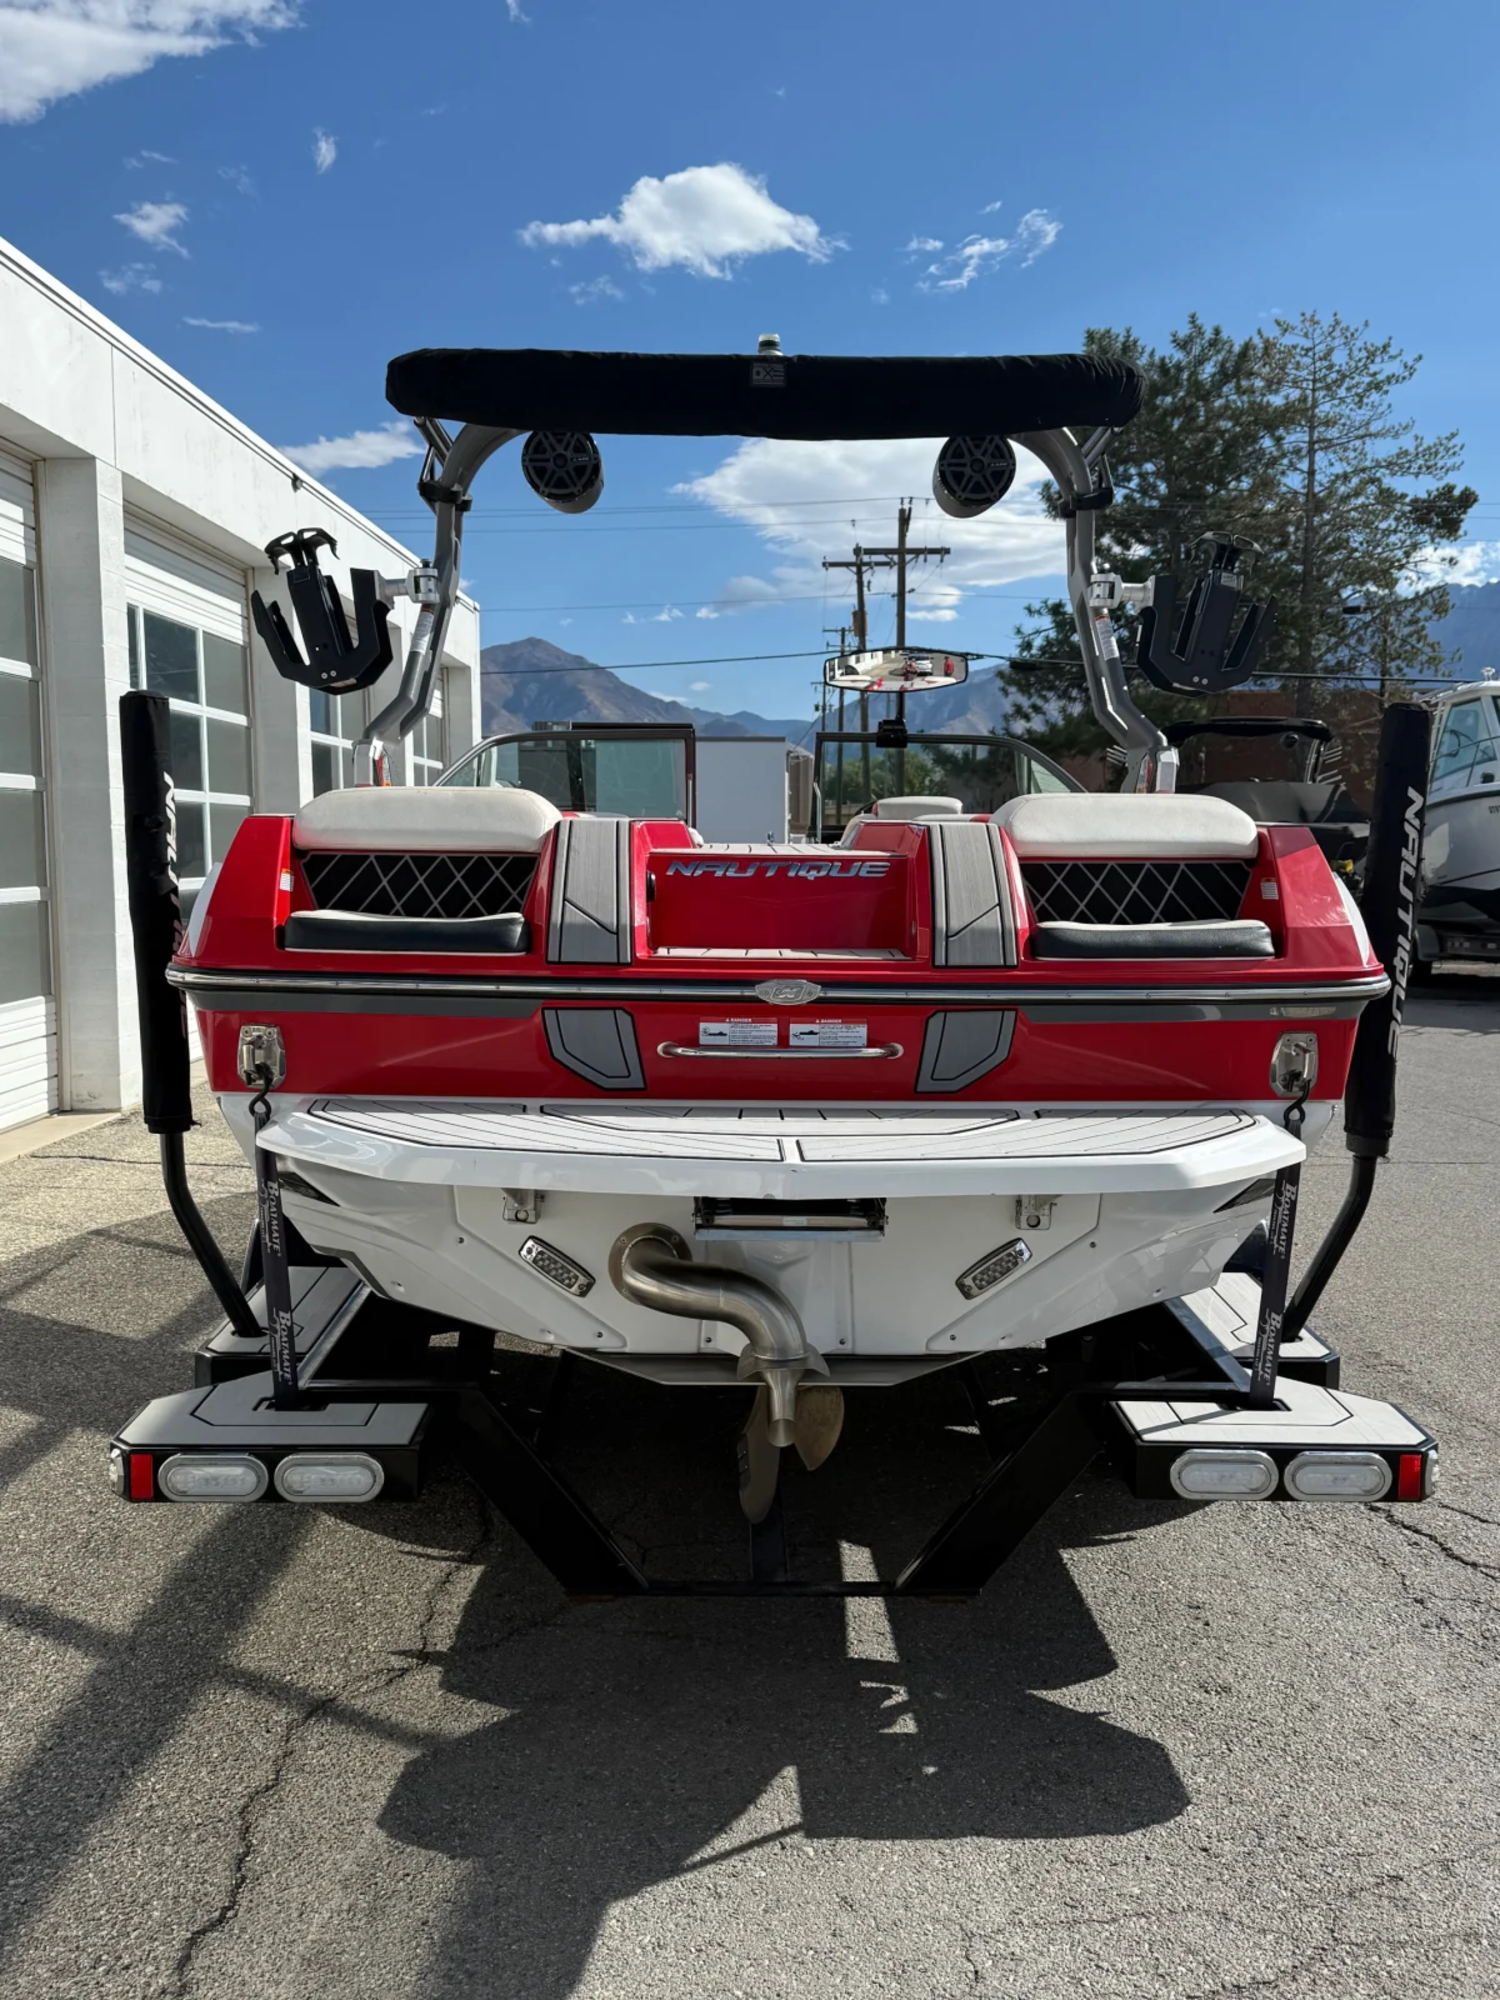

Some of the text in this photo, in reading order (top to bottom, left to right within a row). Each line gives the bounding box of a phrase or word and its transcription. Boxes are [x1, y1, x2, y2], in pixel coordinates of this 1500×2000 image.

[666, 861, 890, 880] NAUTIQUE
[1387, 786, 1424, 1059] NAUTIQUE
[1278, 1183, 1297, 1254] BOATMATE
[278, 1310, 292, 1381] BOATMATE
[1263, 1312, 1283, 1382] BOATMATE
